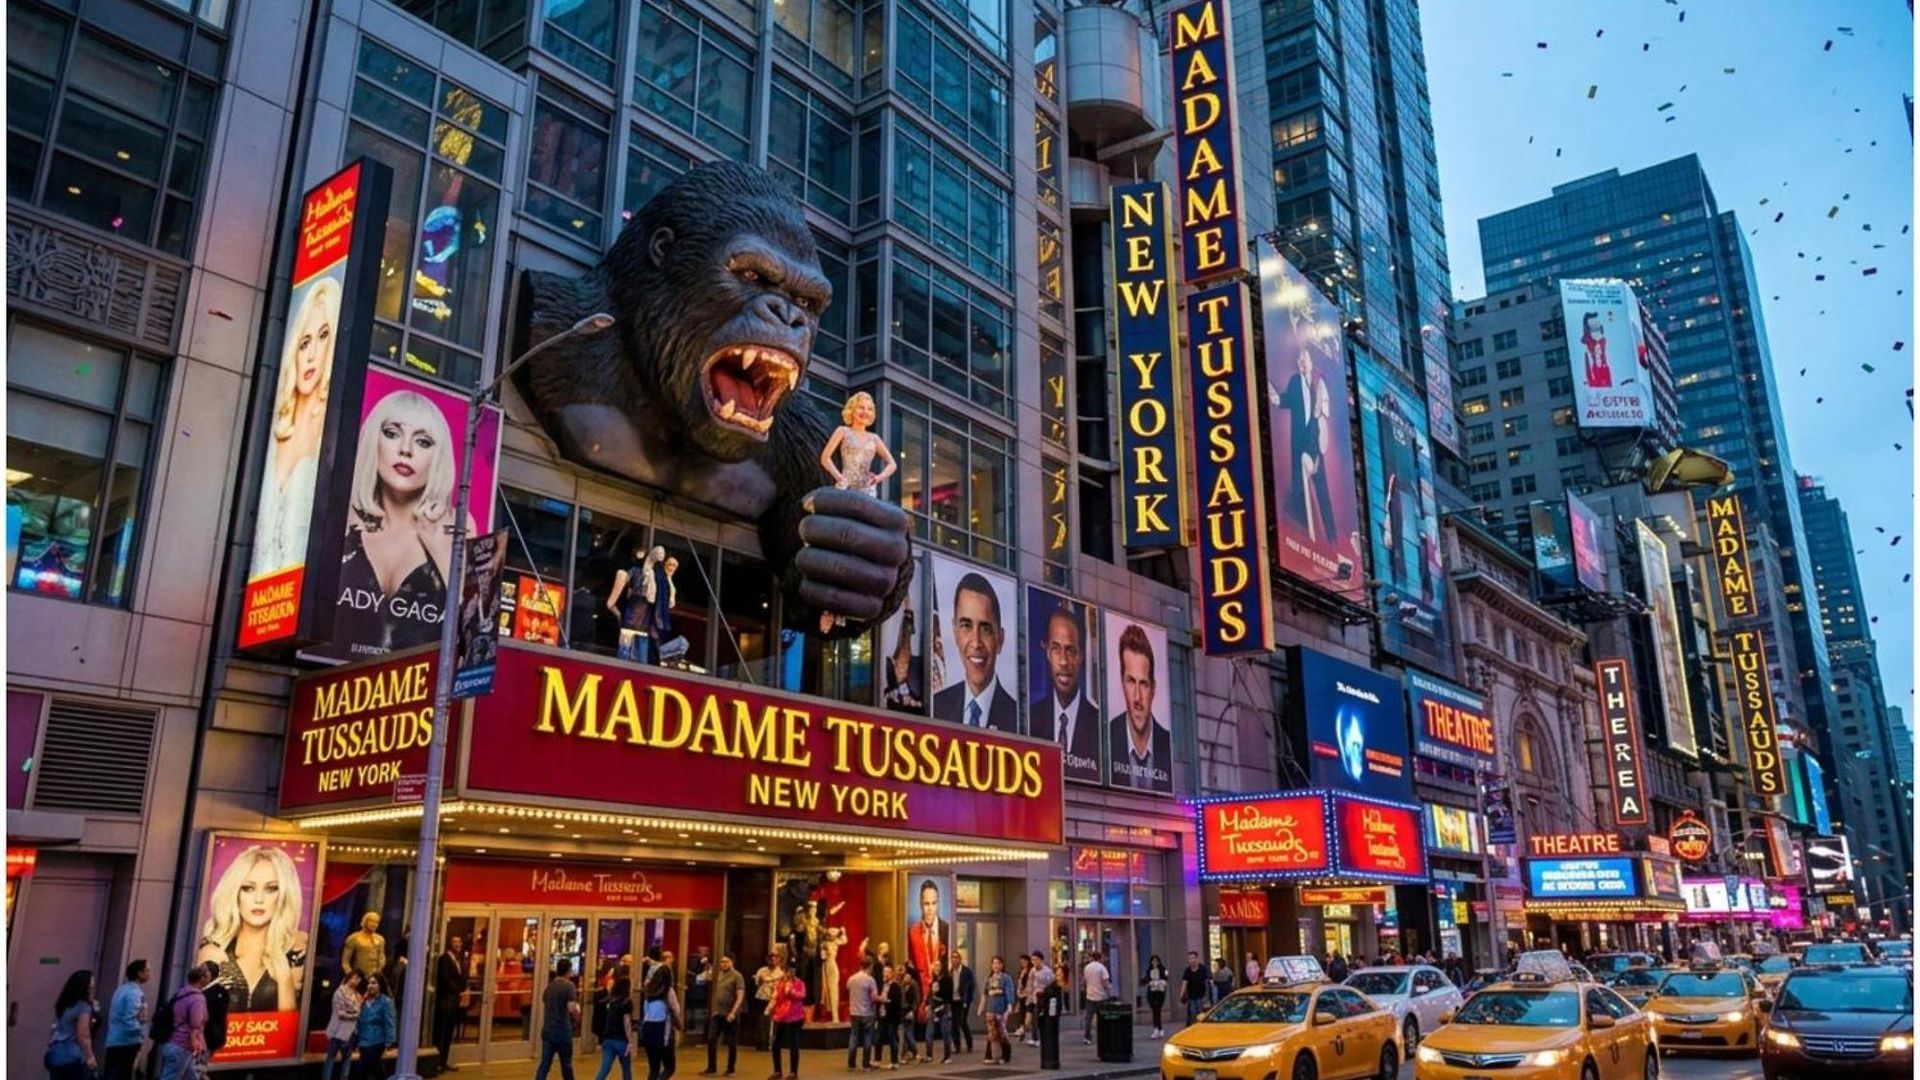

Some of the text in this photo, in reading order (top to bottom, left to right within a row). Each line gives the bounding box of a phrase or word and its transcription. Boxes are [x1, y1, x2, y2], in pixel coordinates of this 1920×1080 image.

[1174, 1, 1231, 271] MADAME
[1118, 192, 1171, 534] NEW YORK
[1197, 296, 1249, 643] TUSSAUDS
[1711, 498, 1749, 615] MADAME
[312, 662, 430, 722] MADAME
[1734, 631, 1777, 792] TUSSAUDS
[302, 706, 435, 766] TUSSAUDS
[535, 665, 1043, 799] MADAME TUSSAUDS
[318, 759, 402, 793] NEW YORK
[749, 773, 909, 821] NEW YORK
[1219, 804, 1299, 833] Madame
[1531, 834, 1621, 854] THEATRE
[530, 868, 594, 893] Madame
